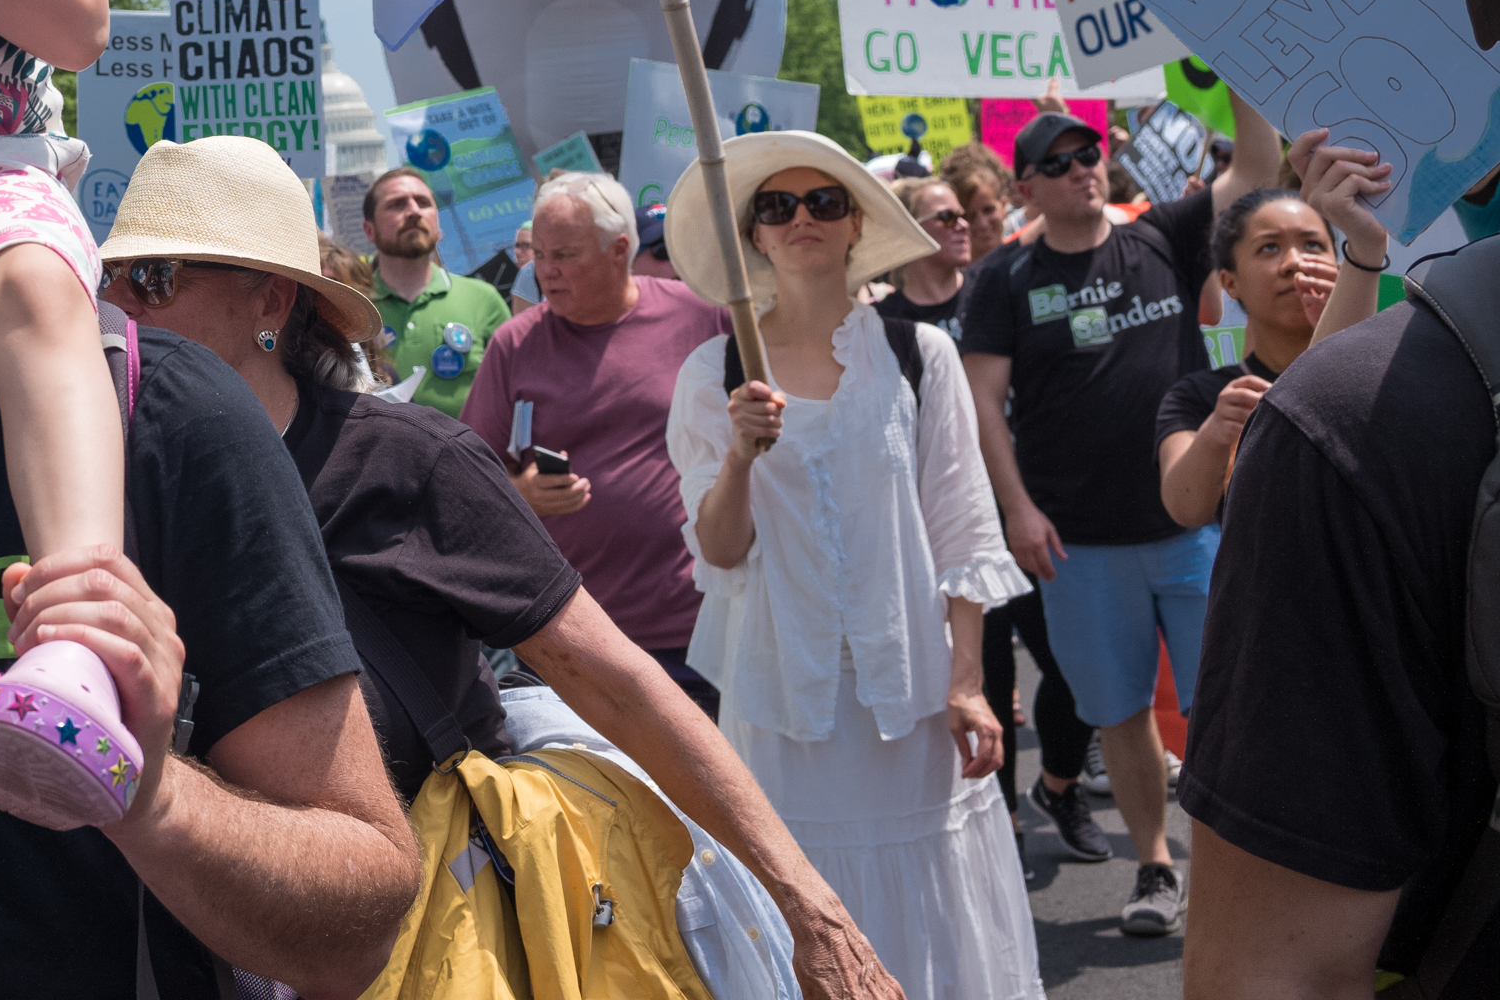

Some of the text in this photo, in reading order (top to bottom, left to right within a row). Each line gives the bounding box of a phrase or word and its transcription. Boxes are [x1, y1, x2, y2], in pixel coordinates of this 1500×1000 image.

[104, 33, 154, 51] ess
[179, 36, 314, 81] CHAOS
[865, 30, 1071, 78] GO VEGA
[96, 57, 154, 78] Less
[180, 80, 316, 120] WITH CLEAN
[1031, 277, 1123, 318] Bernie
[1072, 294, 1183, 340] Sanders
